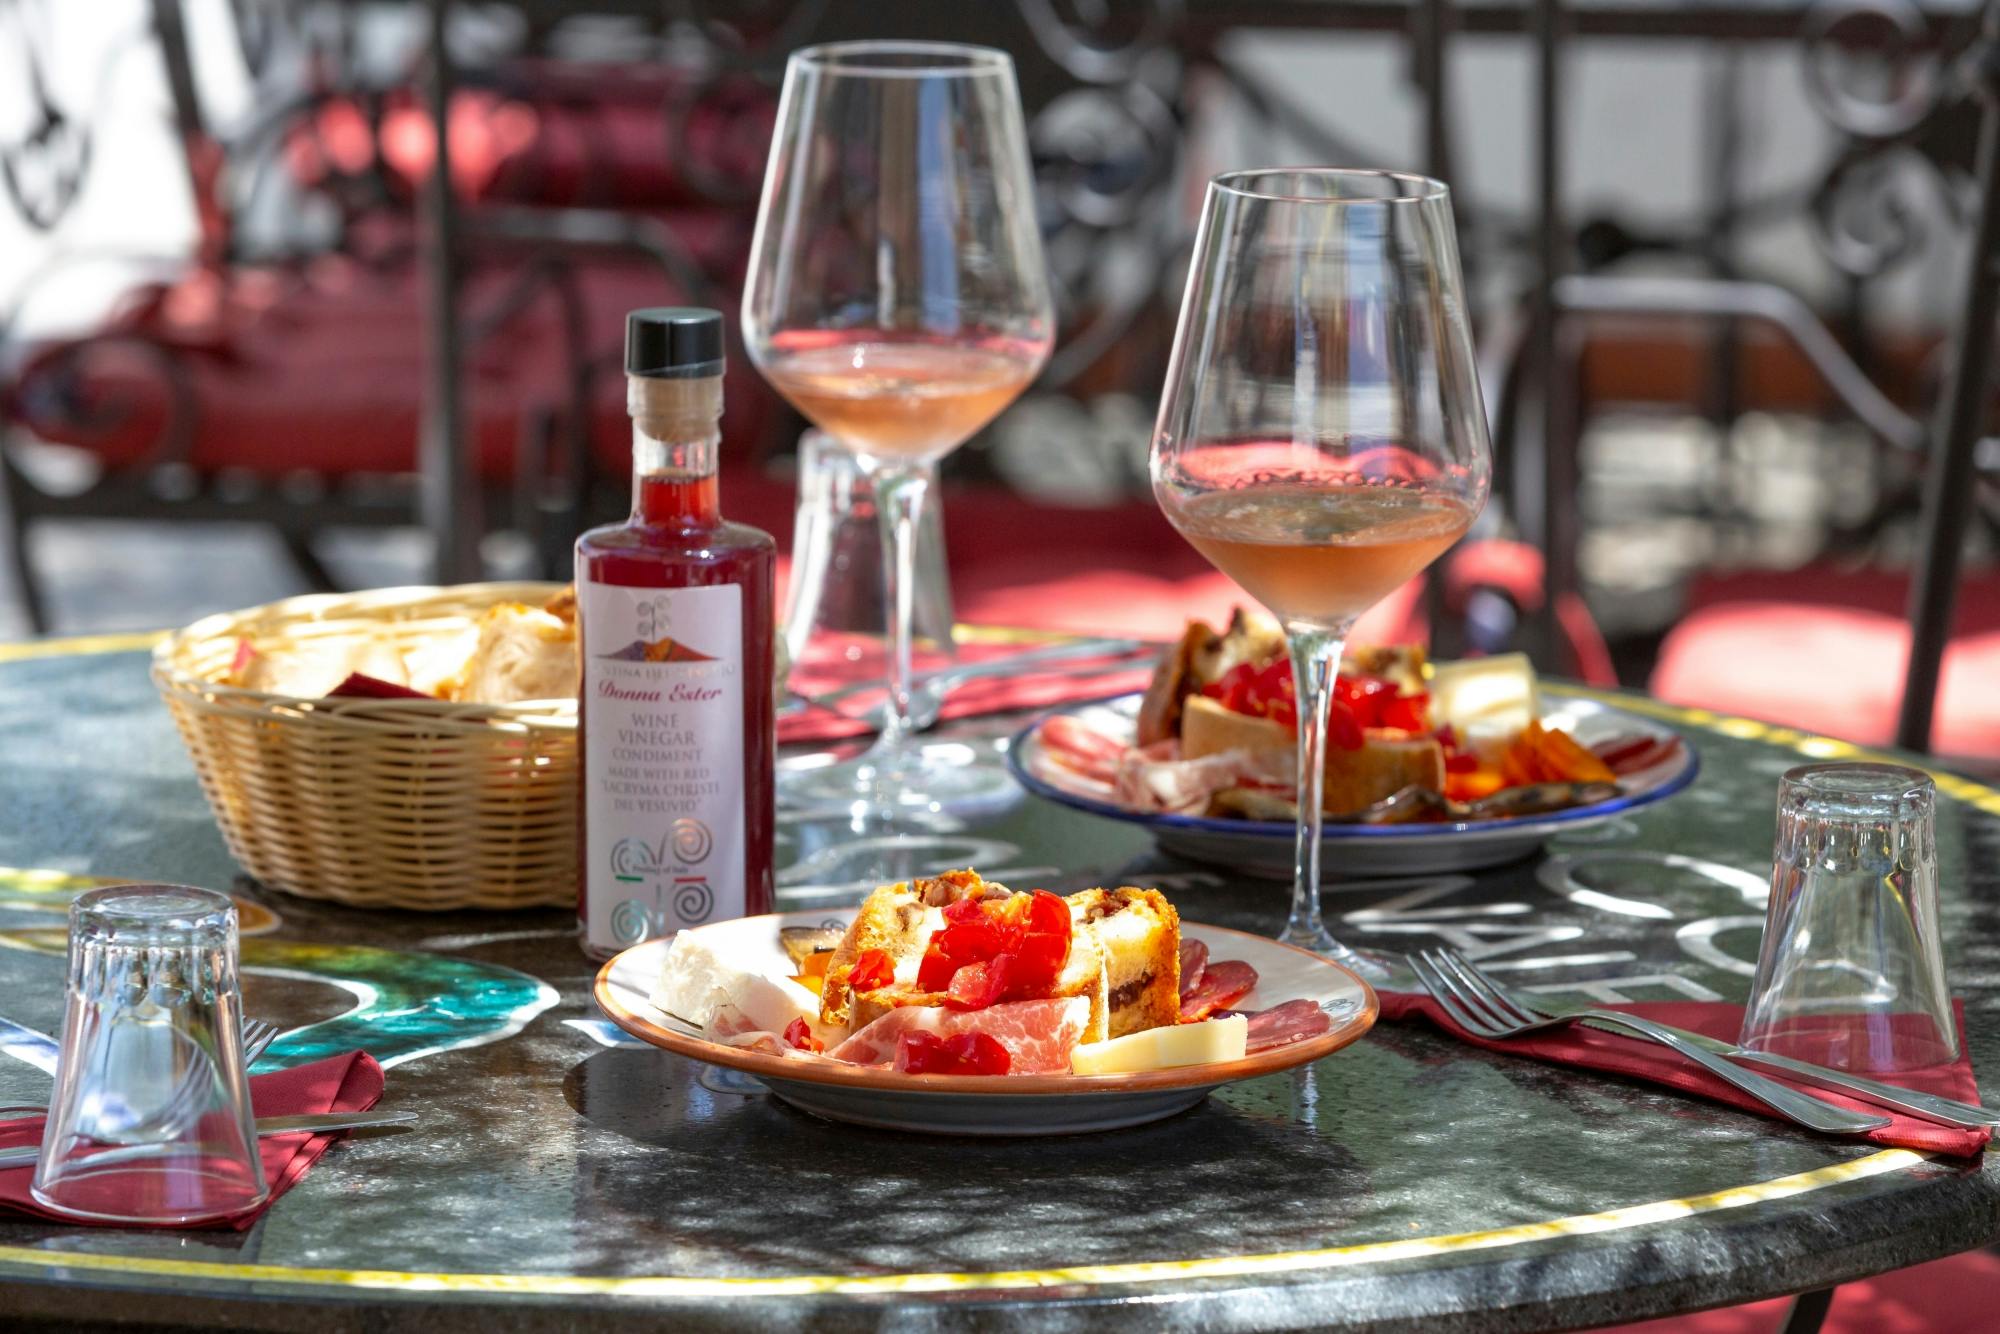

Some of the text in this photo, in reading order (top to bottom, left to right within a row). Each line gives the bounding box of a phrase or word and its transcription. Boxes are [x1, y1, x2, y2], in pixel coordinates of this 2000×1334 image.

[598, 680, 723, 702] Donna Ester
[631, 712, 679, 728] WINE
[618, 729, 697, 746] VINEGAR
[611, 747, 704, 763] CONDIMENT
[608, 766, 710, 780] MADE WITH RED
[663, 781, 720, 796] CHRISTI
[614, 798, 633, 812] DEL
